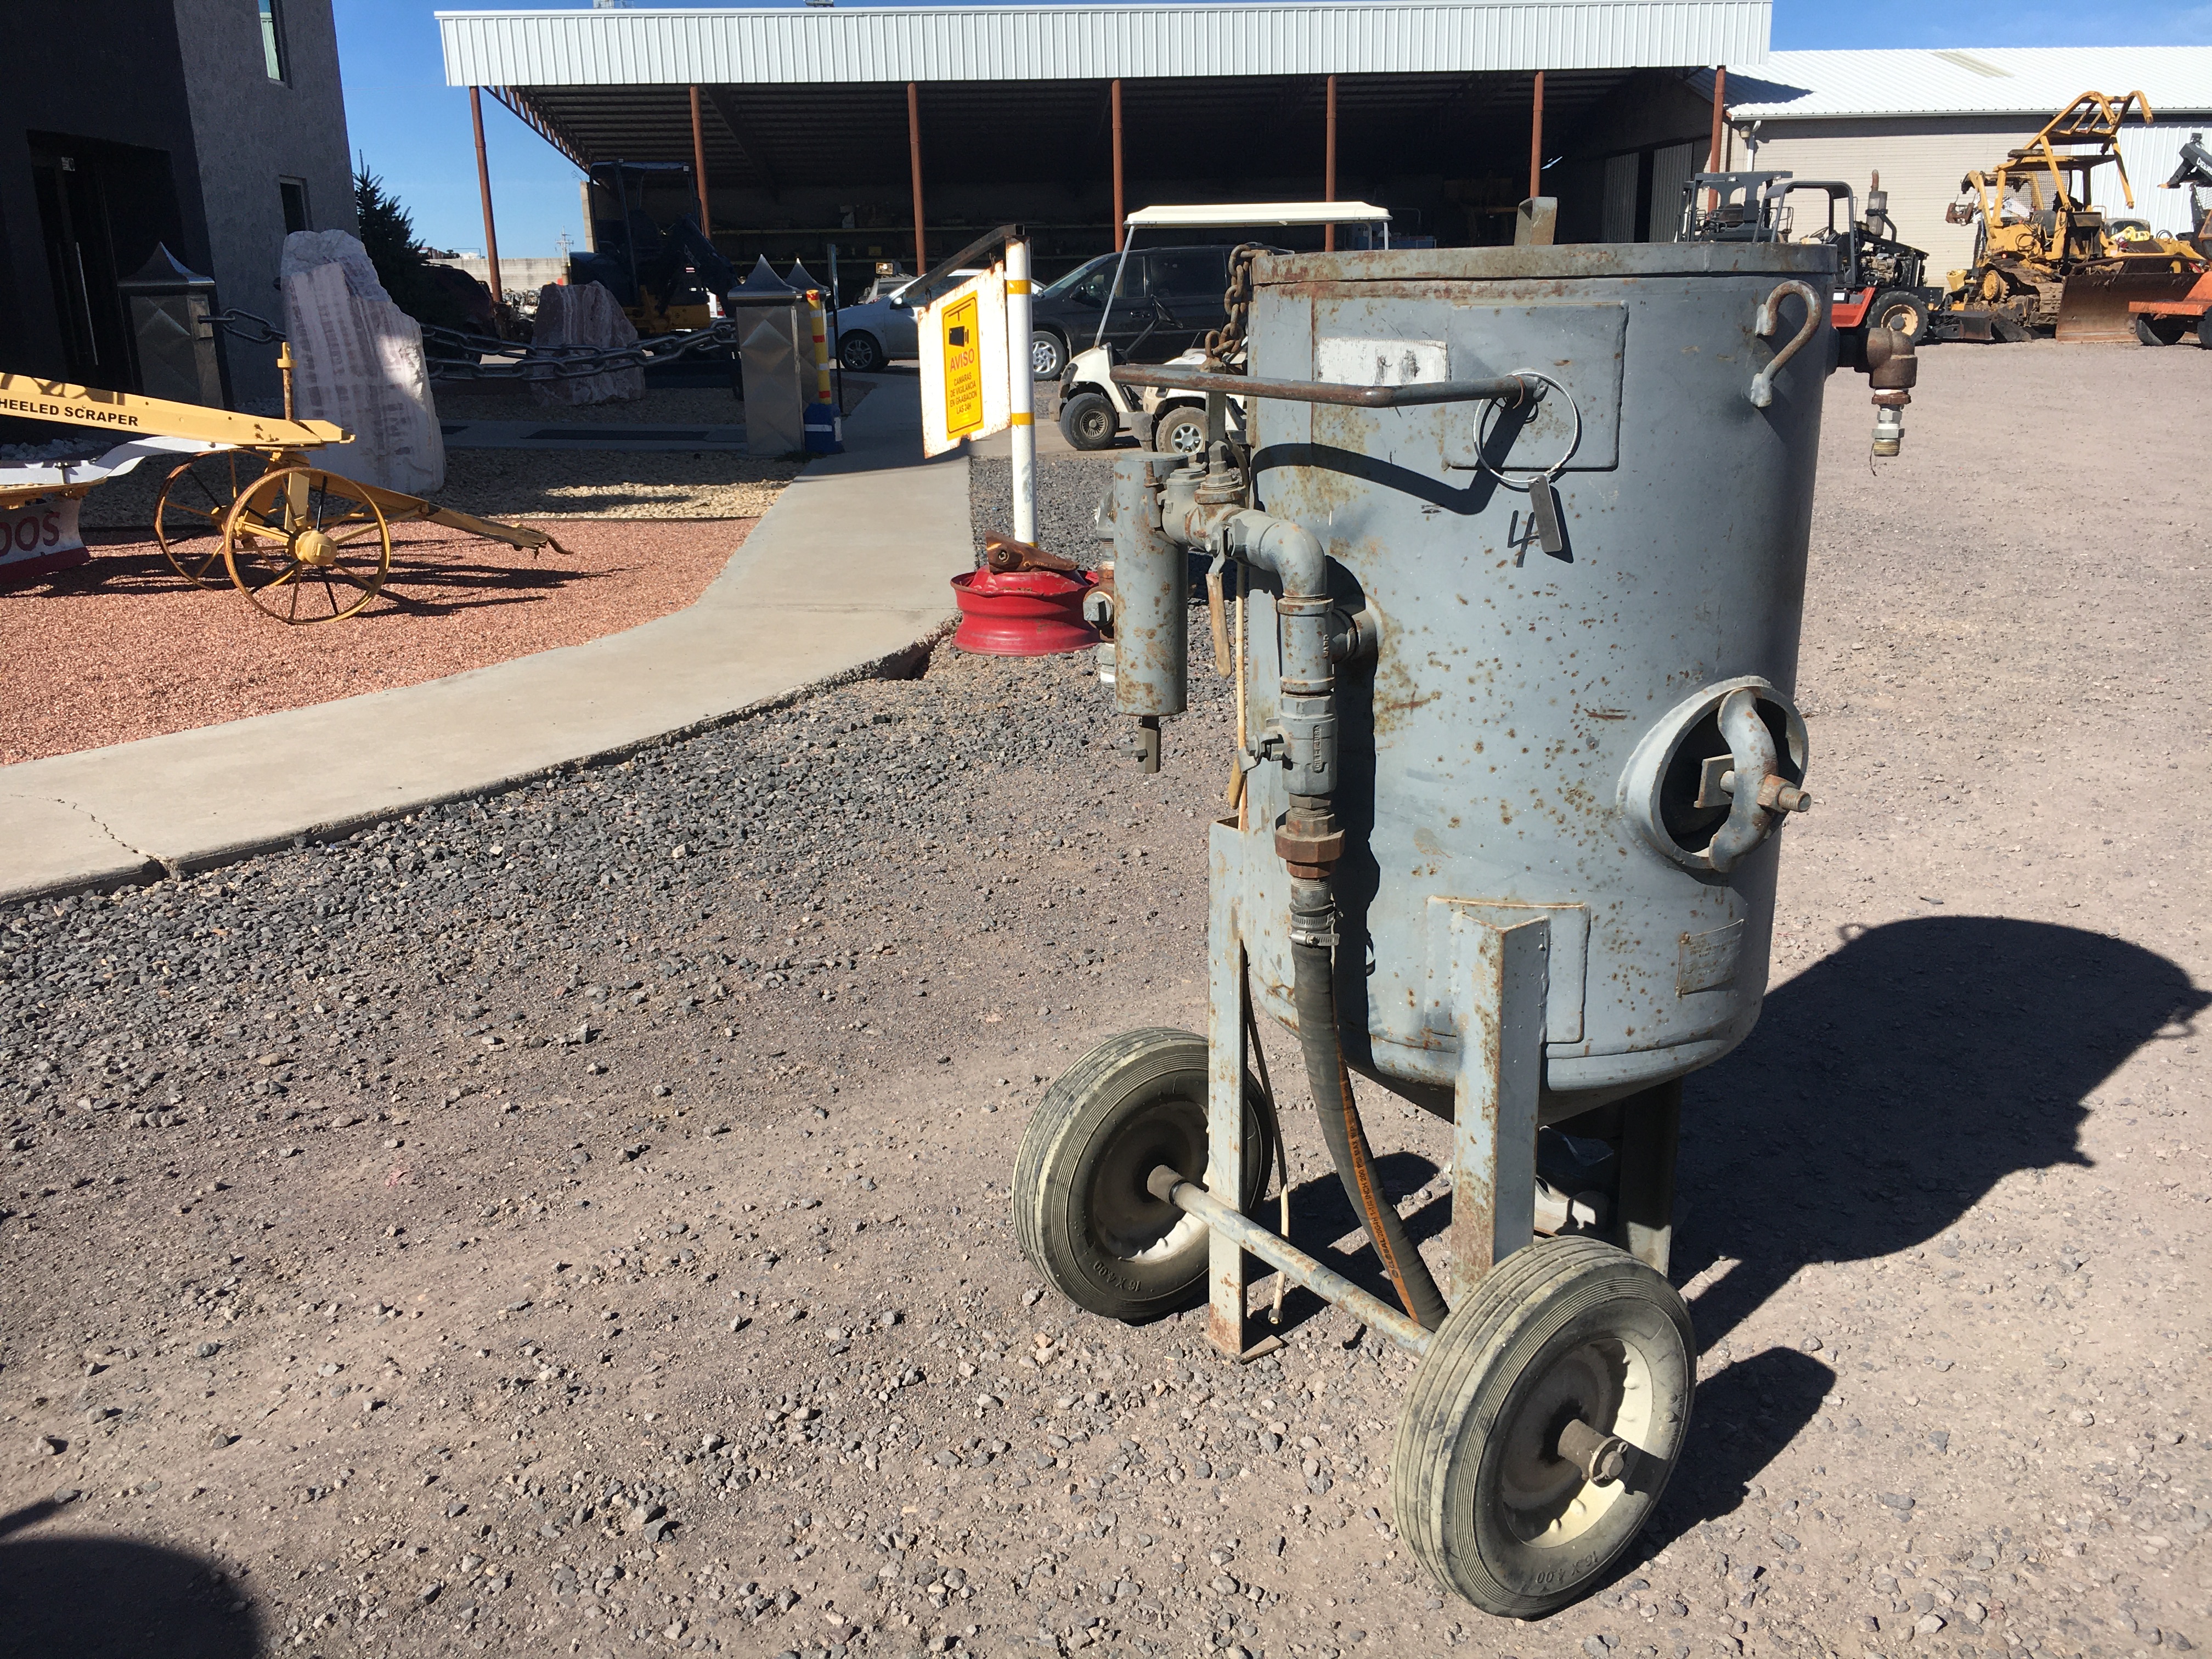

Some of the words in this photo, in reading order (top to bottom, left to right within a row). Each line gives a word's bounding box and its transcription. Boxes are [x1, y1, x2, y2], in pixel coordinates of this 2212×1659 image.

[950, 348, 975, 373] AVISO
[953, 372, 972, 386] CAMARAS
[950, 389, 956, 398] DE
[956, 380, 977, 395] VIGILANCIA
[950, 398, 955, 408] EN
[956, 390, 977, 405] GRABACION
[0, 398, 59, 416] HEELED
[64, 407, 138, 427] SCRAPER
[1358, 1169, 1366, 1182] 200
[1362, 1182, 1372, 1199] INCH
[1367, 1200, 1376, 1216] 1-1/4
[1380, 1238, 1395, 1268] GLOBAL
[1585, 1550, 1598, 1567] 16
